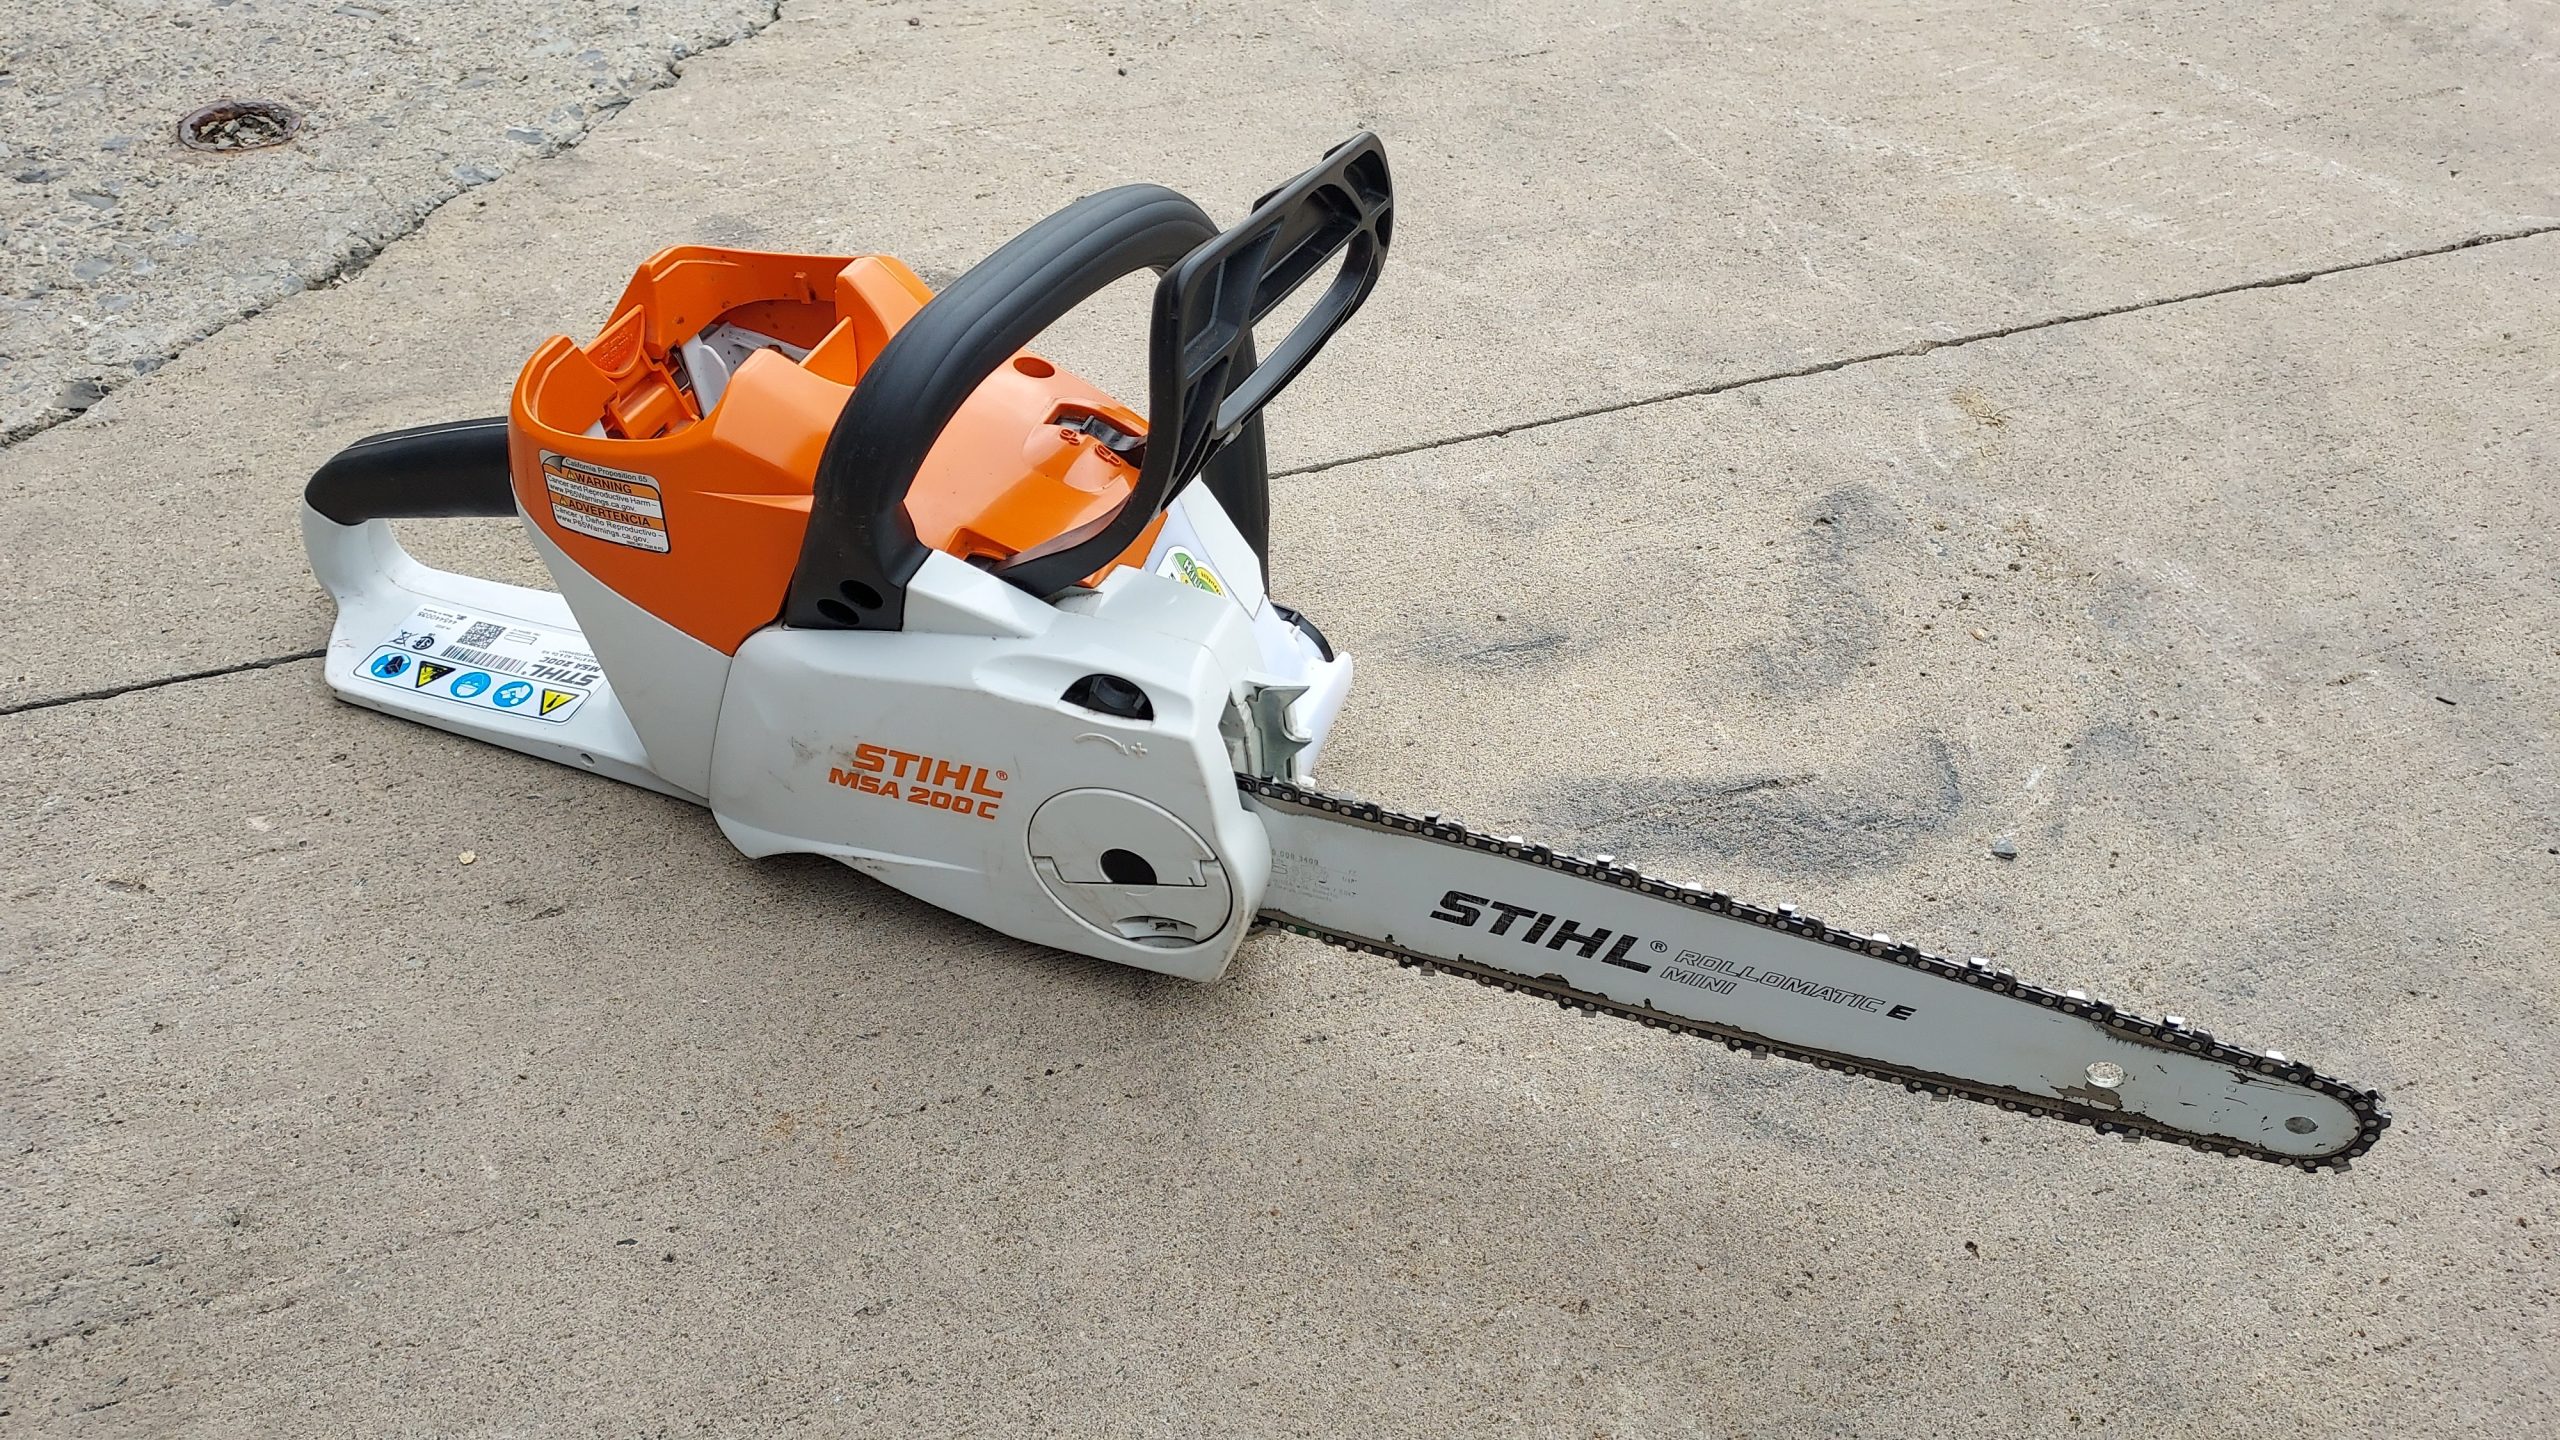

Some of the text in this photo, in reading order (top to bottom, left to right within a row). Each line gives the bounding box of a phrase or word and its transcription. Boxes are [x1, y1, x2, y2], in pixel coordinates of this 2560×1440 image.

[565, 458, 648, 483] California Proposition 65
[575, 472, 632, 494] WARNING
[547, 474, 570, 487] Cancer
[570, 482, 583, 492] and
[583, 486, 630, 502] Reproductive
[630, 496, 651, 507] Harm
[569, 499, 651, 527] ADVERTENCIA
[605, 520, 657, 538] Reproductivo
[528, 663, 600, 687] STIHL
[573, 663, 601, 673] MSA
[828, 767, 900, 800] MSA
[1660, 965, 1738, 996] MINI
[1674, 948, 1917, 1022] ROLLOMATIC E
